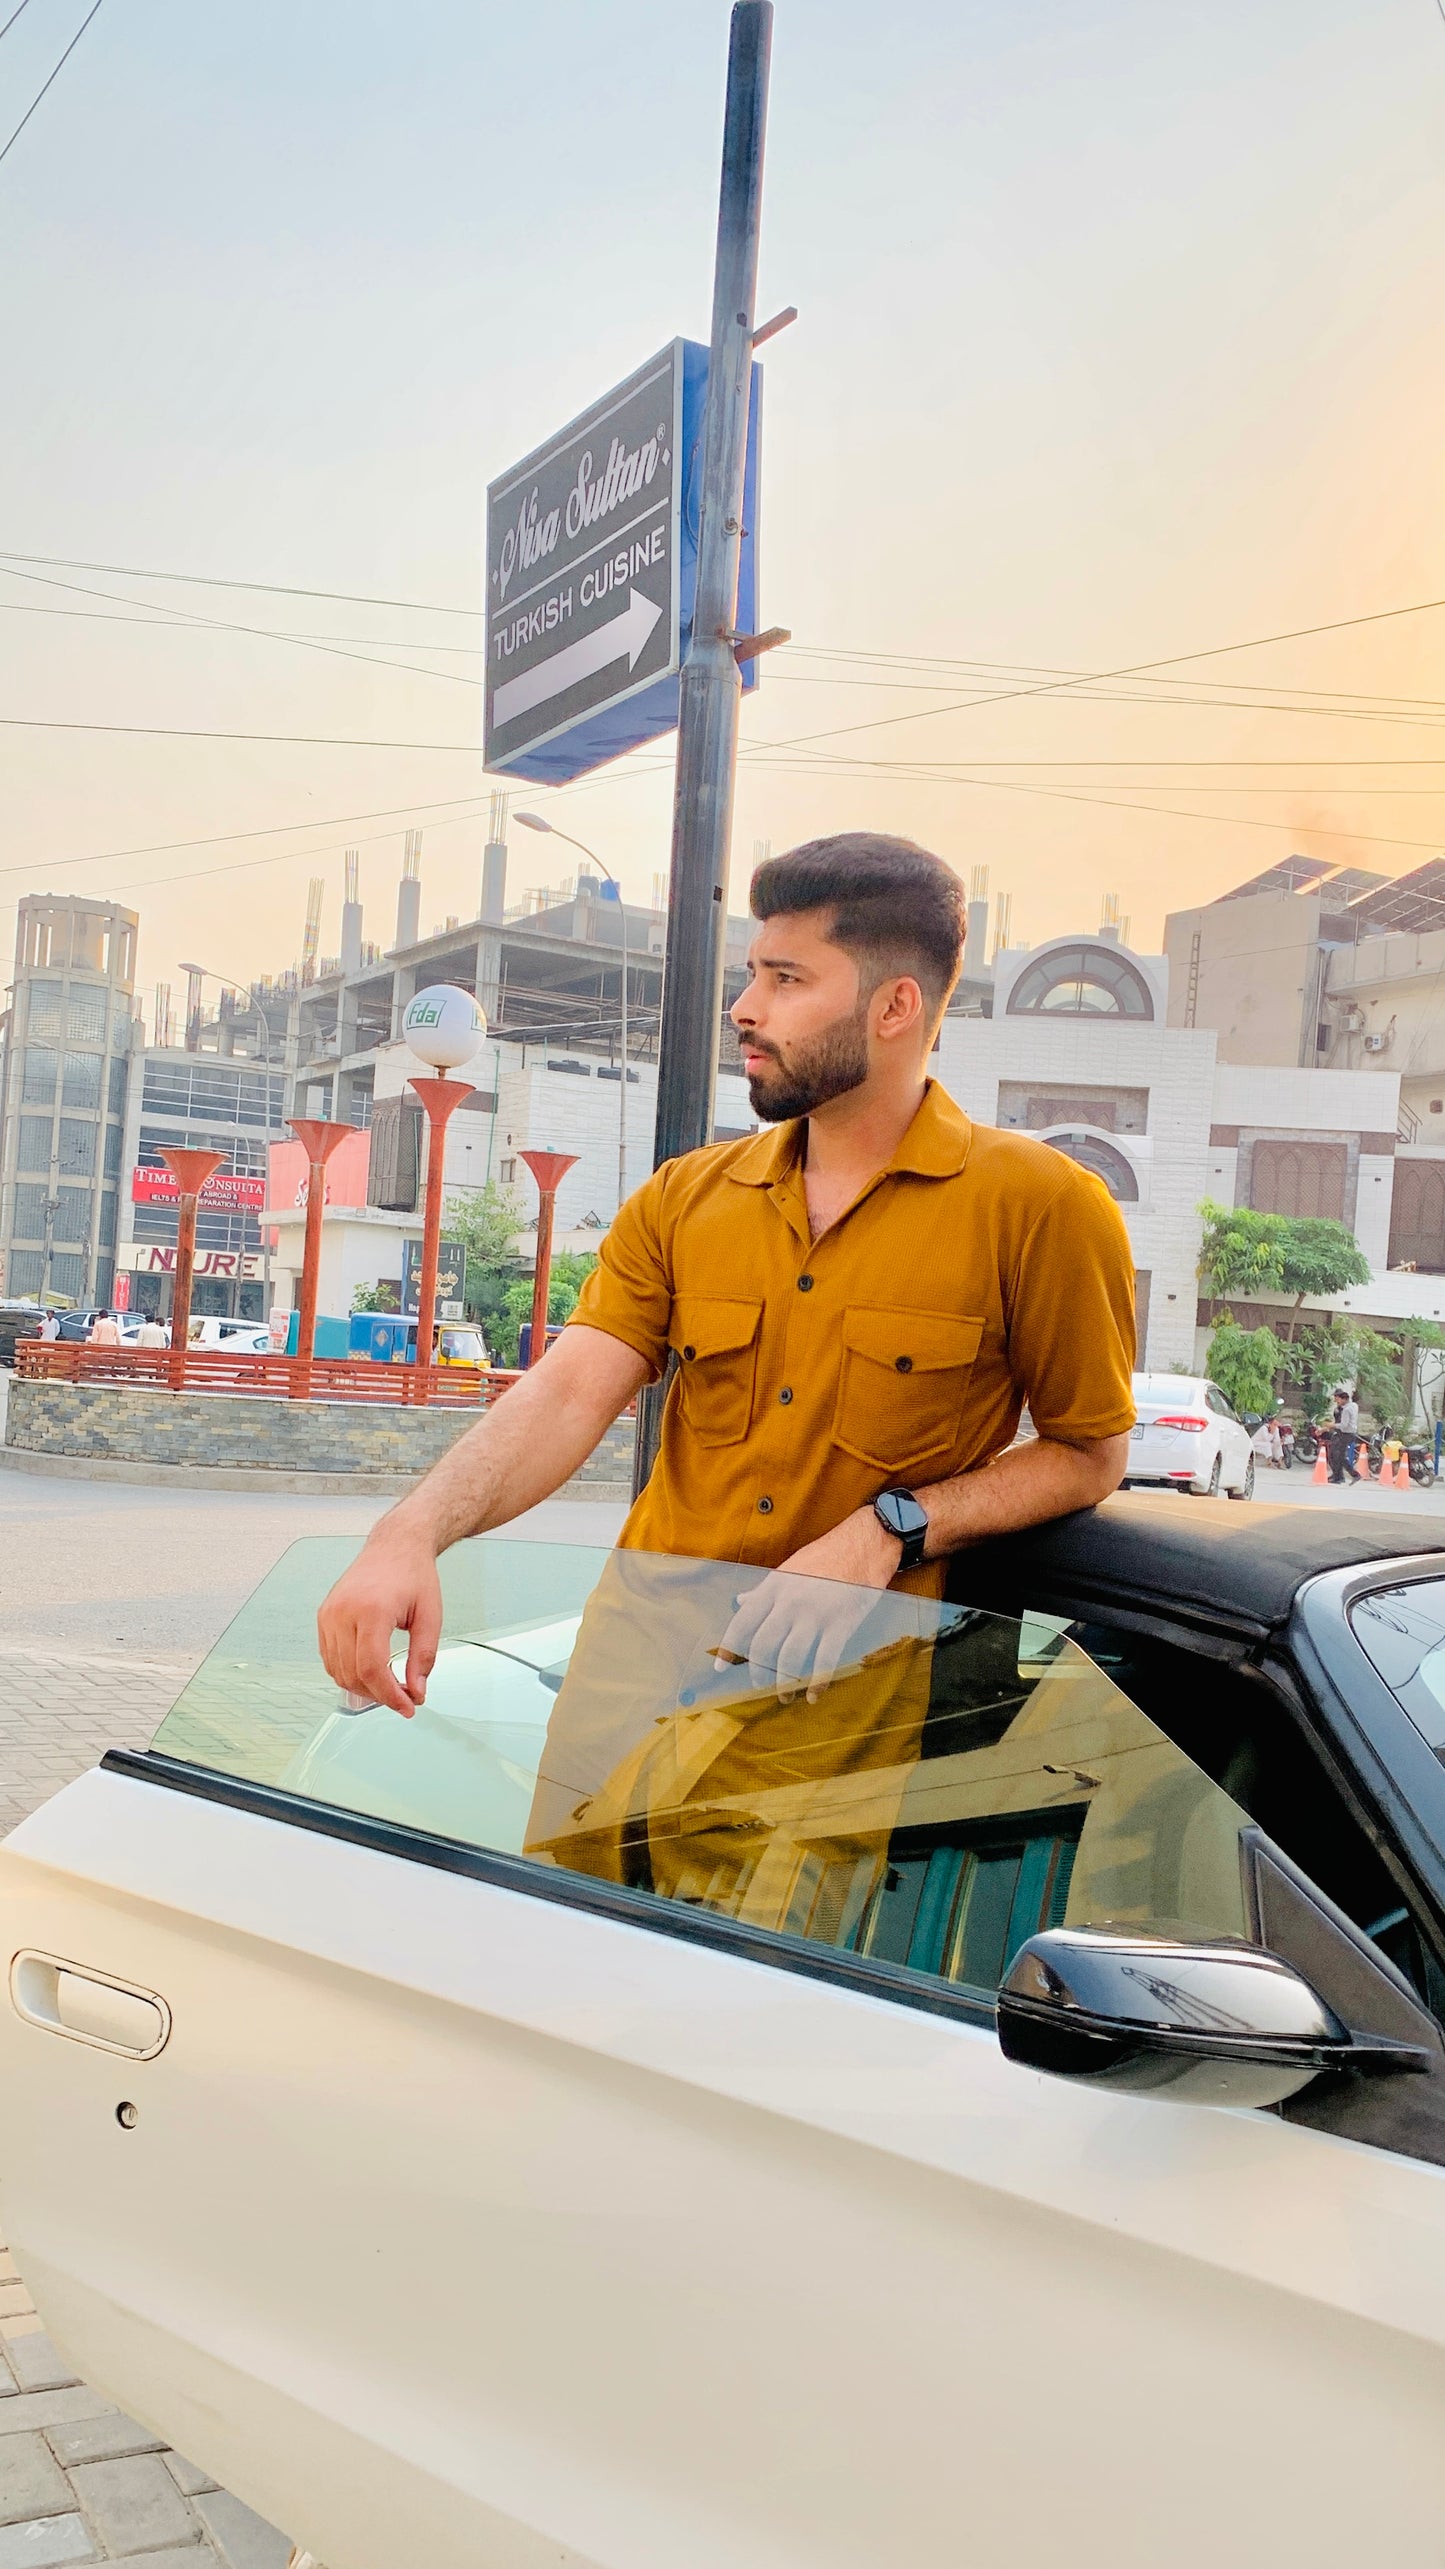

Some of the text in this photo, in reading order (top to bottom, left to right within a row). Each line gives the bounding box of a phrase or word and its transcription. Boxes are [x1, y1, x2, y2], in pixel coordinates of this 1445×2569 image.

[499, 486, 561, 602] Nisa
[494, 524, 666, 660] TURKISH CUISINE
[136, 1168, 177, 1186] TIME
[151, 1193, 170, 1202] IELTS
[203, 1191, 231, 1200] ABROAD
